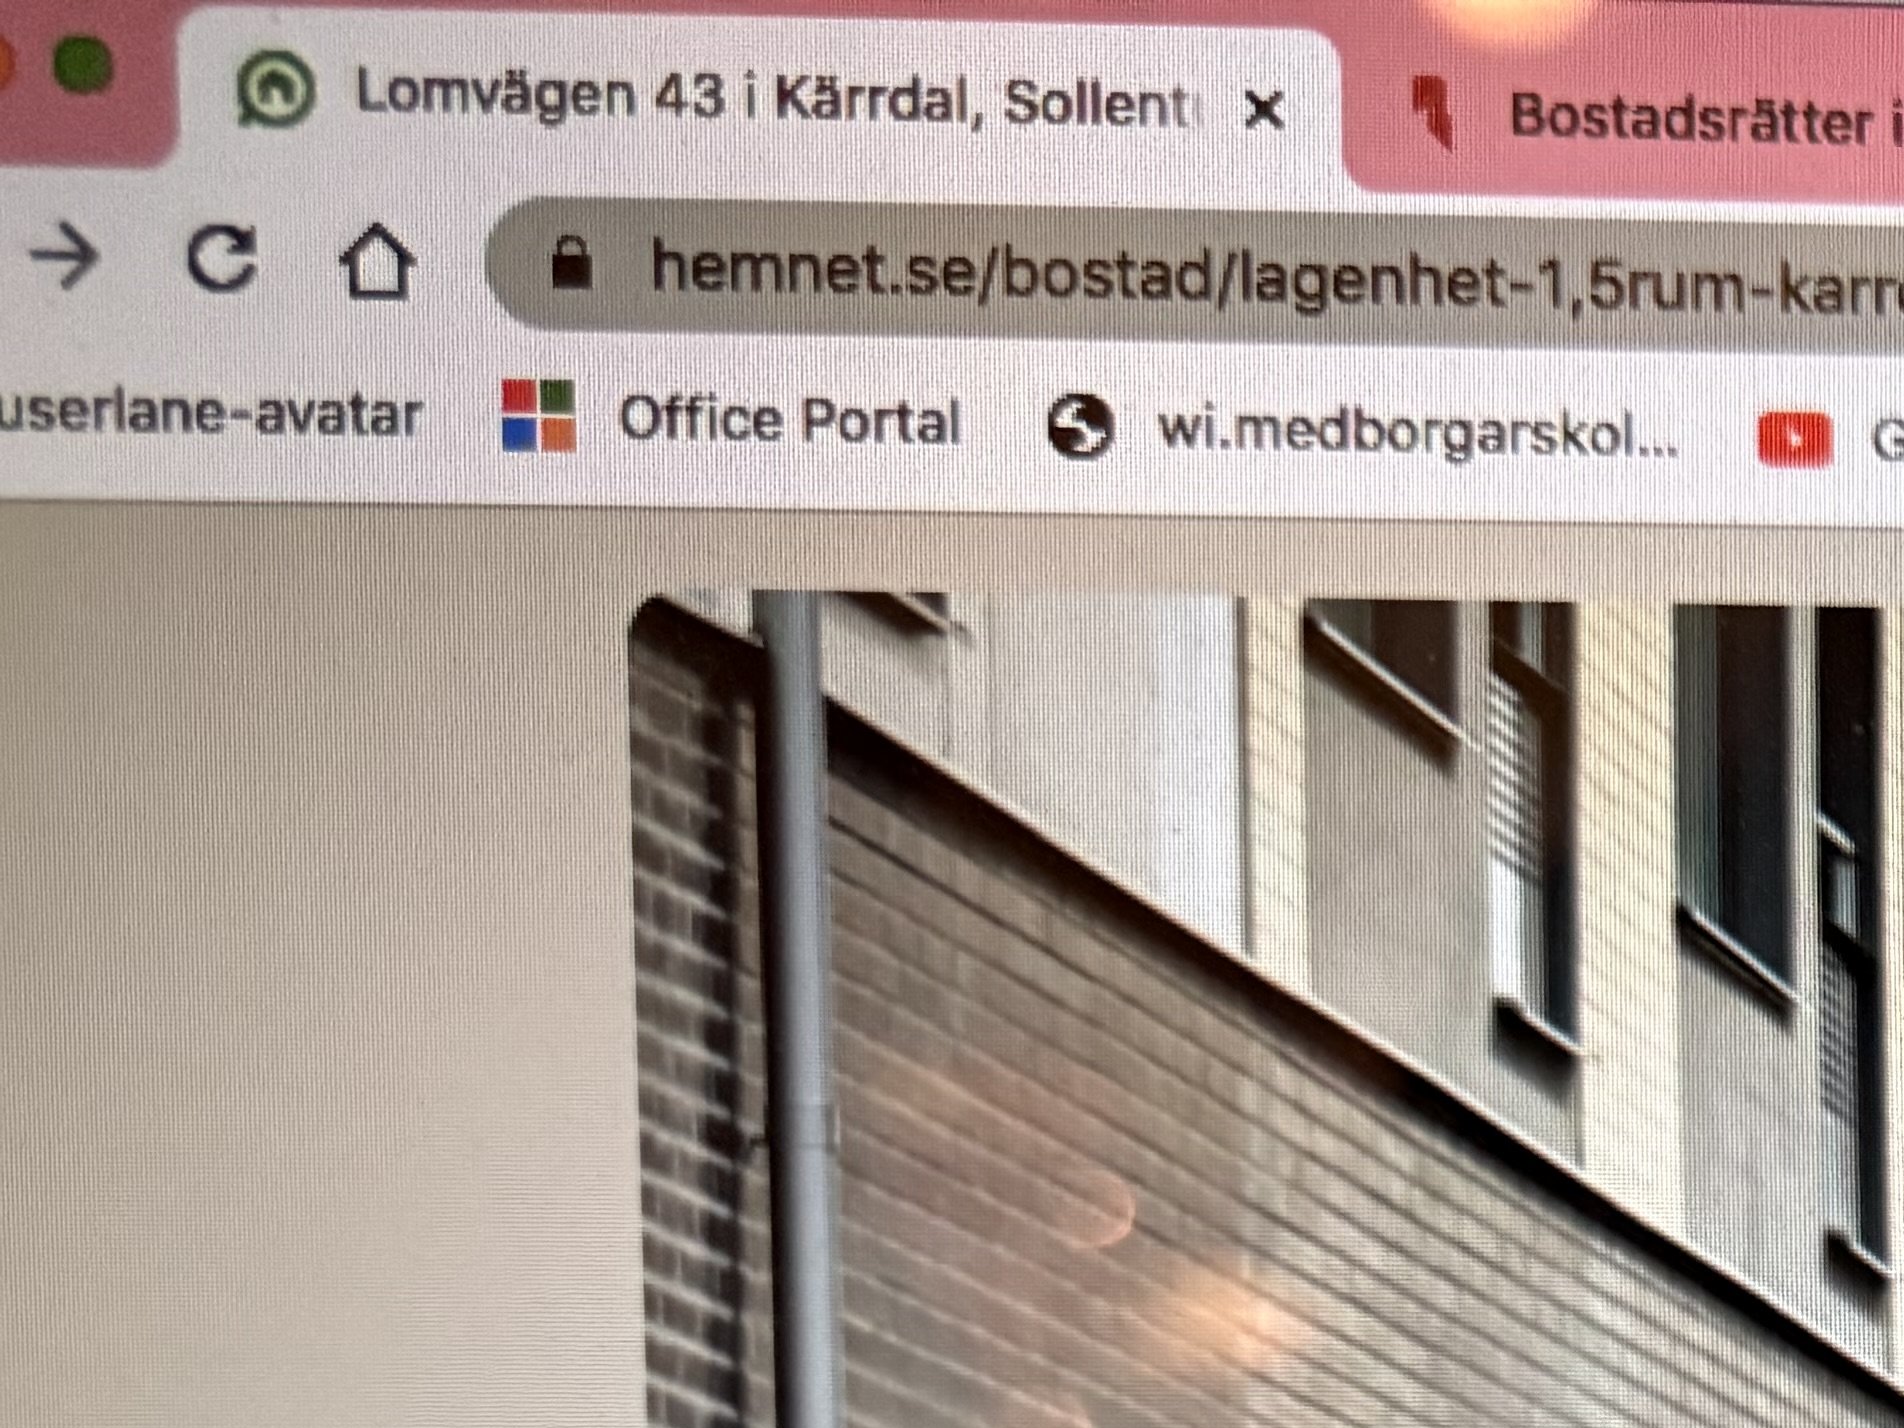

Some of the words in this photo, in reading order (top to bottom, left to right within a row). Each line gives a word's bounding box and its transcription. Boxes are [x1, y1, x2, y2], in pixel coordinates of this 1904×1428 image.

[356, 65, 636, 128] Lomvägen
[654, 71, 725, 119] 43
[743, 68, 756, 119] i
[775, 73, 983, 132] Kärrdal,
[1510, 90, 1874, 147] Bostadsrätter
[1891, 97, 1904, 147] i
[619, 392, 783, 443] Office
[801, 396, 961, 445] Portal
[1157, 401, 1679, 467] wi.medborgarskol...
